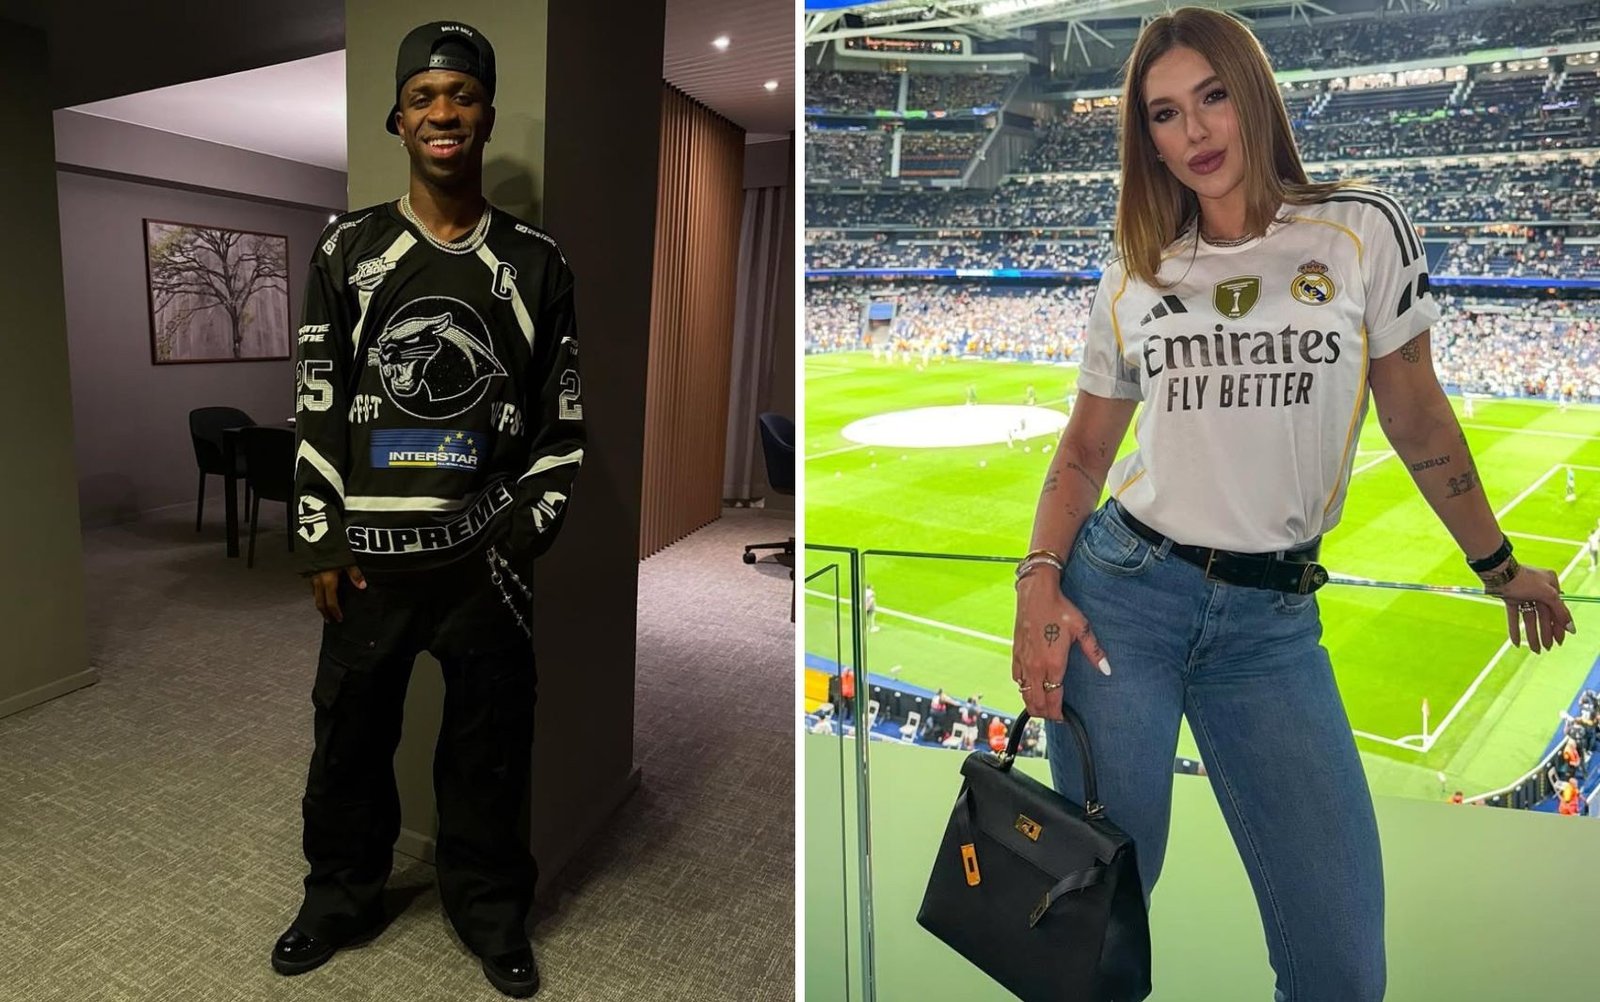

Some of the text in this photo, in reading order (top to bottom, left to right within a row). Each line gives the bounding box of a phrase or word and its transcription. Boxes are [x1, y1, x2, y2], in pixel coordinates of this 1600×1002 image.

[491, 262, 517, 300] C
[1143, 324, 1340, 378] Emirates
[1167, 372, 1313, 412] FLY BETTER
[388, 451, 478, 466] INTERSTAR
[345, 482, 513, 554] SUPREME
